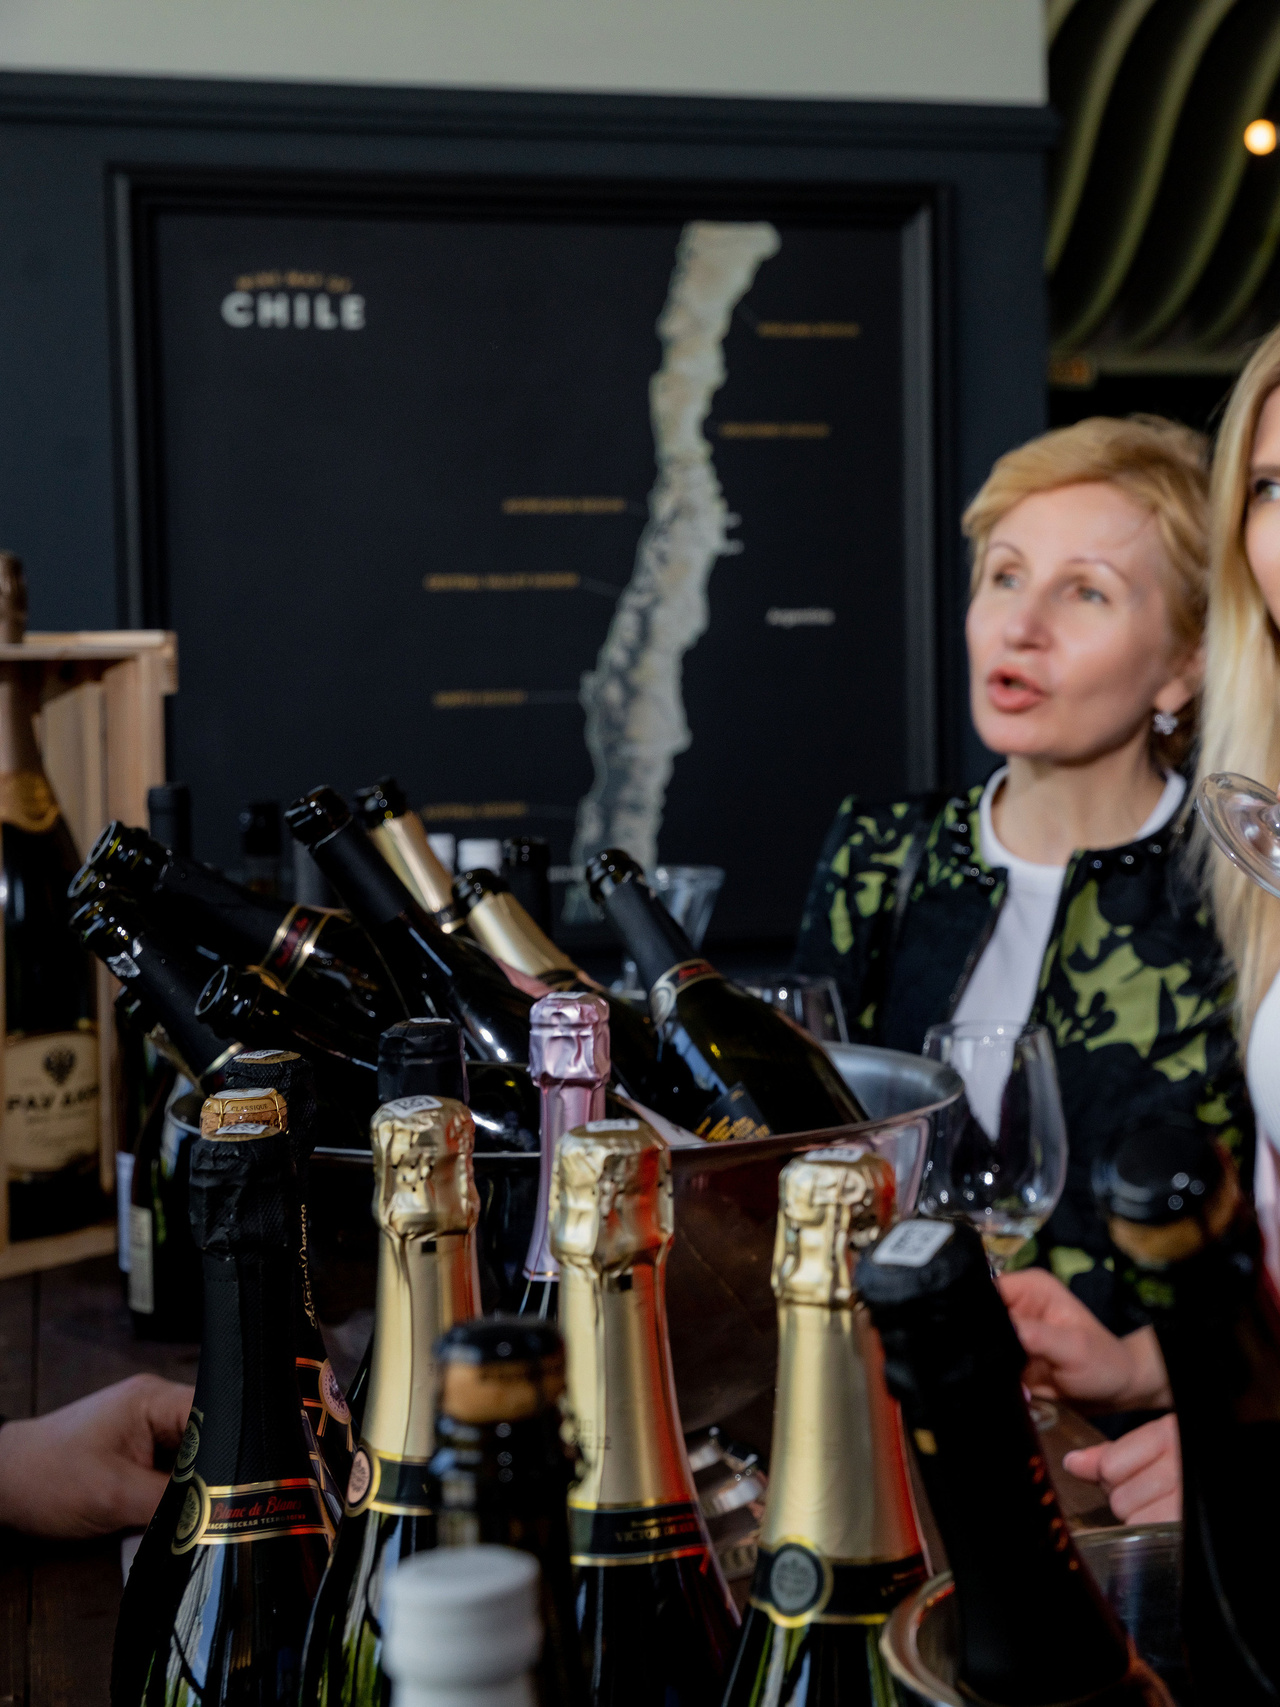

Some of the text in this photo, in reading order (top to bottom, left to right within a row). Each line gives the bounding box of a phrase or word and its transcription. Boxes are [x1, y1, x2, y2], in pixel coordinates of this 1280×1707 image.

[221, 291, 366, 331] CHILE
[231, 1103, 269, 1112] CLASSIQUE
[213, 1496, 302, 1519] Blanc de Blancs
[207, 1520, 258, 1530] ЛАССИЧЕСКАЯ
